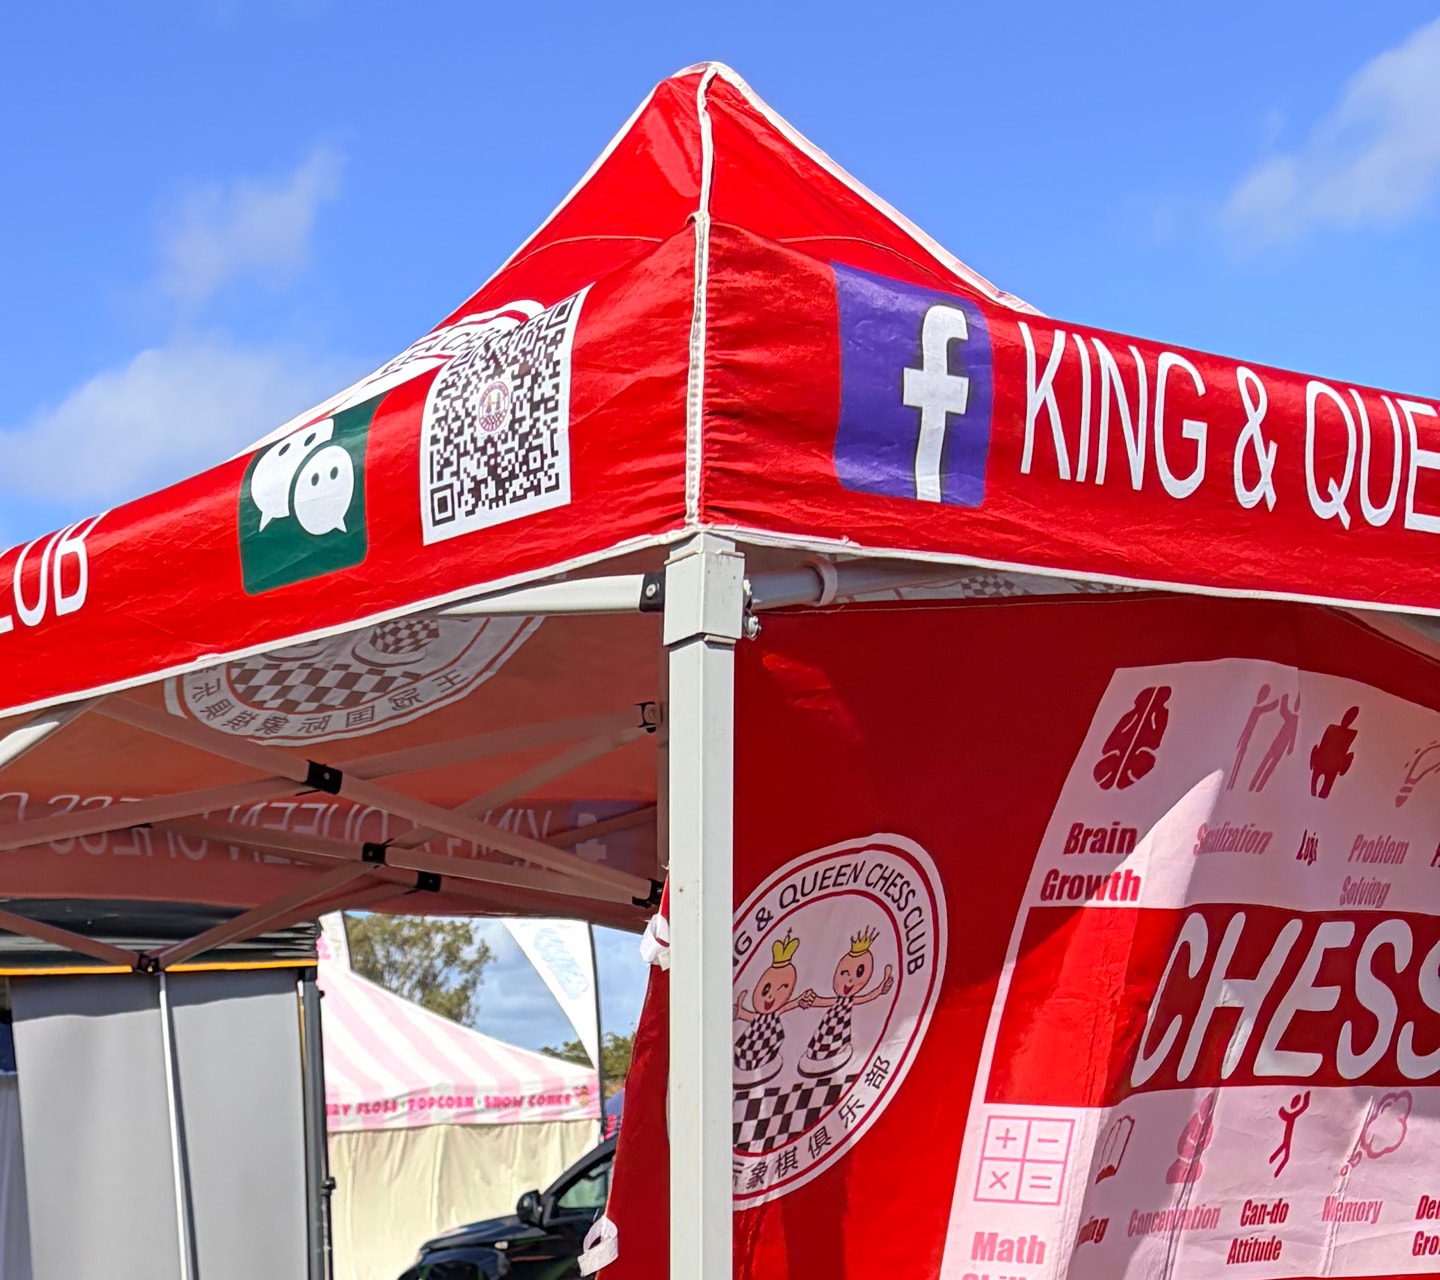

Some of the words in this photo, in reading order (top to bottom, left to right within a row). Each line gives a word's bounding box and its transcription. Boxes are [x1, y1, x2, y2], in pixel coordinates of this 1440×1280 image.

[1017, 322, 1207, 499] KING
[1234, 366, 1277, 512] &
[1063, 821, 1138, 855] Brain
[1347, 833, 1410, 865] Problem
[1040, 867, 1141, 903] Growth
[1339, 875, 1392, 909] Solving
[755, 906, 774, 932] &
[778, 860, 867, 909] QUEEN
[864, 862, 917, 912] CHESS
[902, 905, 927, 976] CLUB
[1239, 1197, 1290, 1228] Can-do
[1321, 1194, 1384, 1225] Memory
[1415, 1194, 1440, 1220] De
[971, 1232, 1046, 1266] Math
[1226, 1235, 1283, 1265] Attitude
[1411, 1230, 1440, 1257] Gro
